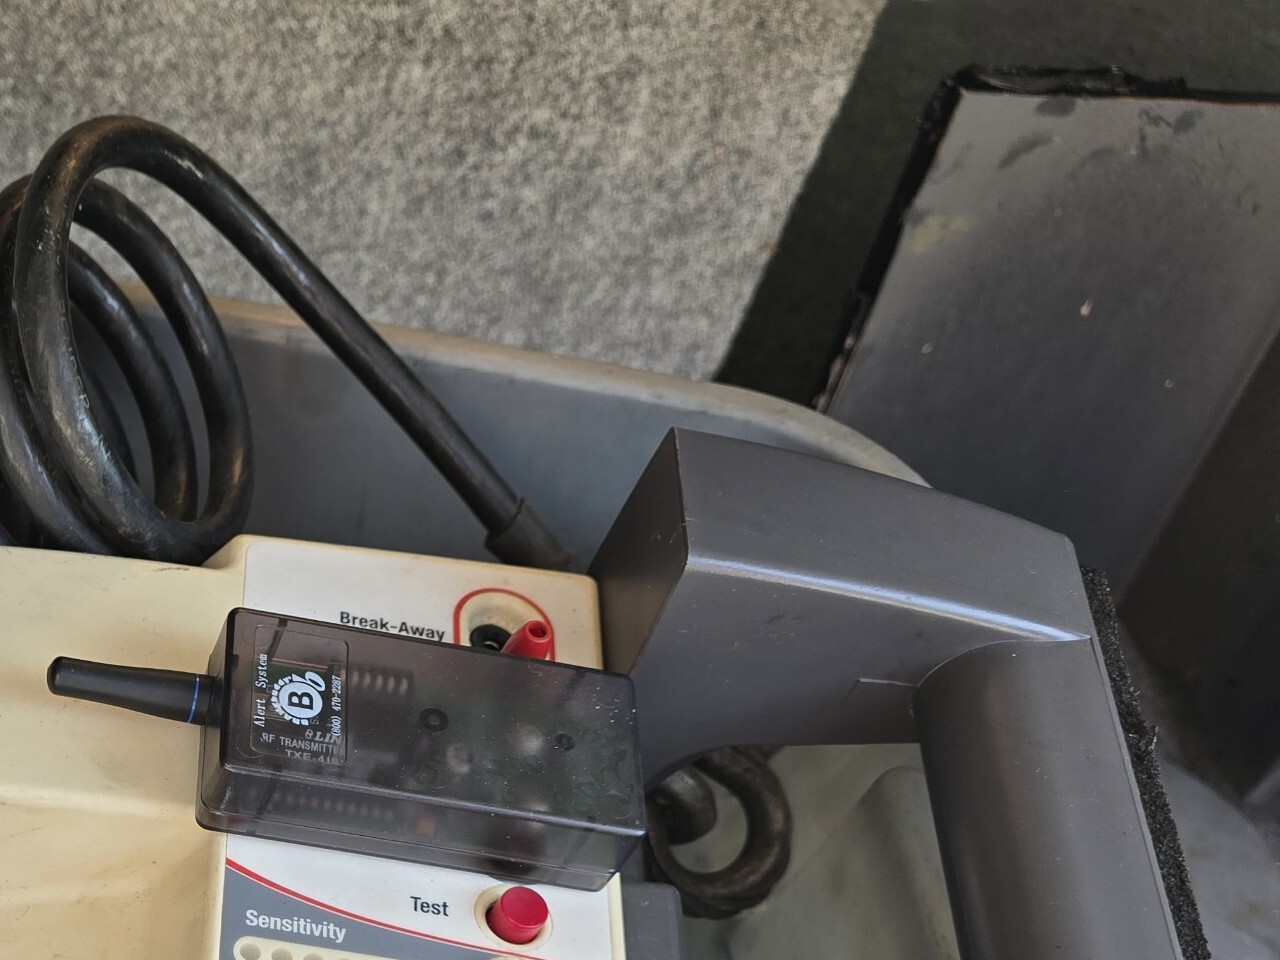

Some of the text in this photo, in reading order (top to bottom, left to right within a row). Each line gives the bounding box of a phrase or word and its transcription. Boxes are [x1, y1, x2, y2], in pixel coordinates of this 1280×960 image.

[339, 611, 446, 641] Break-Away
[253, 653, 268, 728] Alert System
[329, 674, 342, 737] (800) 470-2287
[410, 896, 449, 917] Test
[245, 909, 348, 944] Sensitivity
